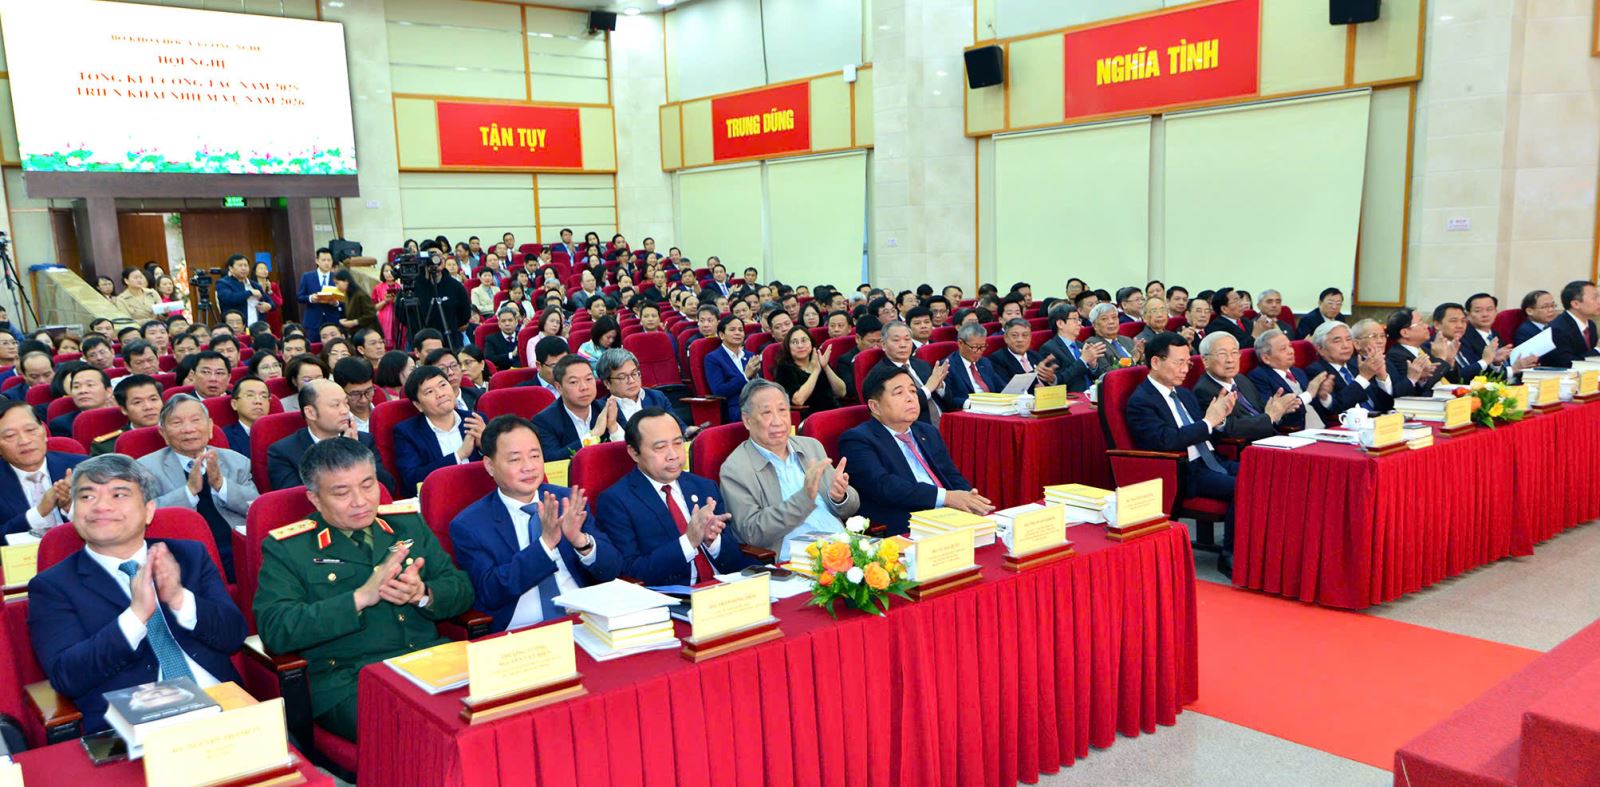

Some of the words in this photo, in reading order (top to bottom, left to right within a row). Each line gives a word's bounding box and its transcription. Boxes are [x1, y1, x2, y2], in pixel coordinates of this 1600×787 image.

[1096, 46, 1160, 86] NGHĨA
[1167, 38, 1219, 75] TÌNH
[479, 122, 514, 152] TẬN
[517, 127, 547, 153] TỤY
[726, 115, 761, 139] TRUNG
[763, 107, 795, 133] DŨNG
